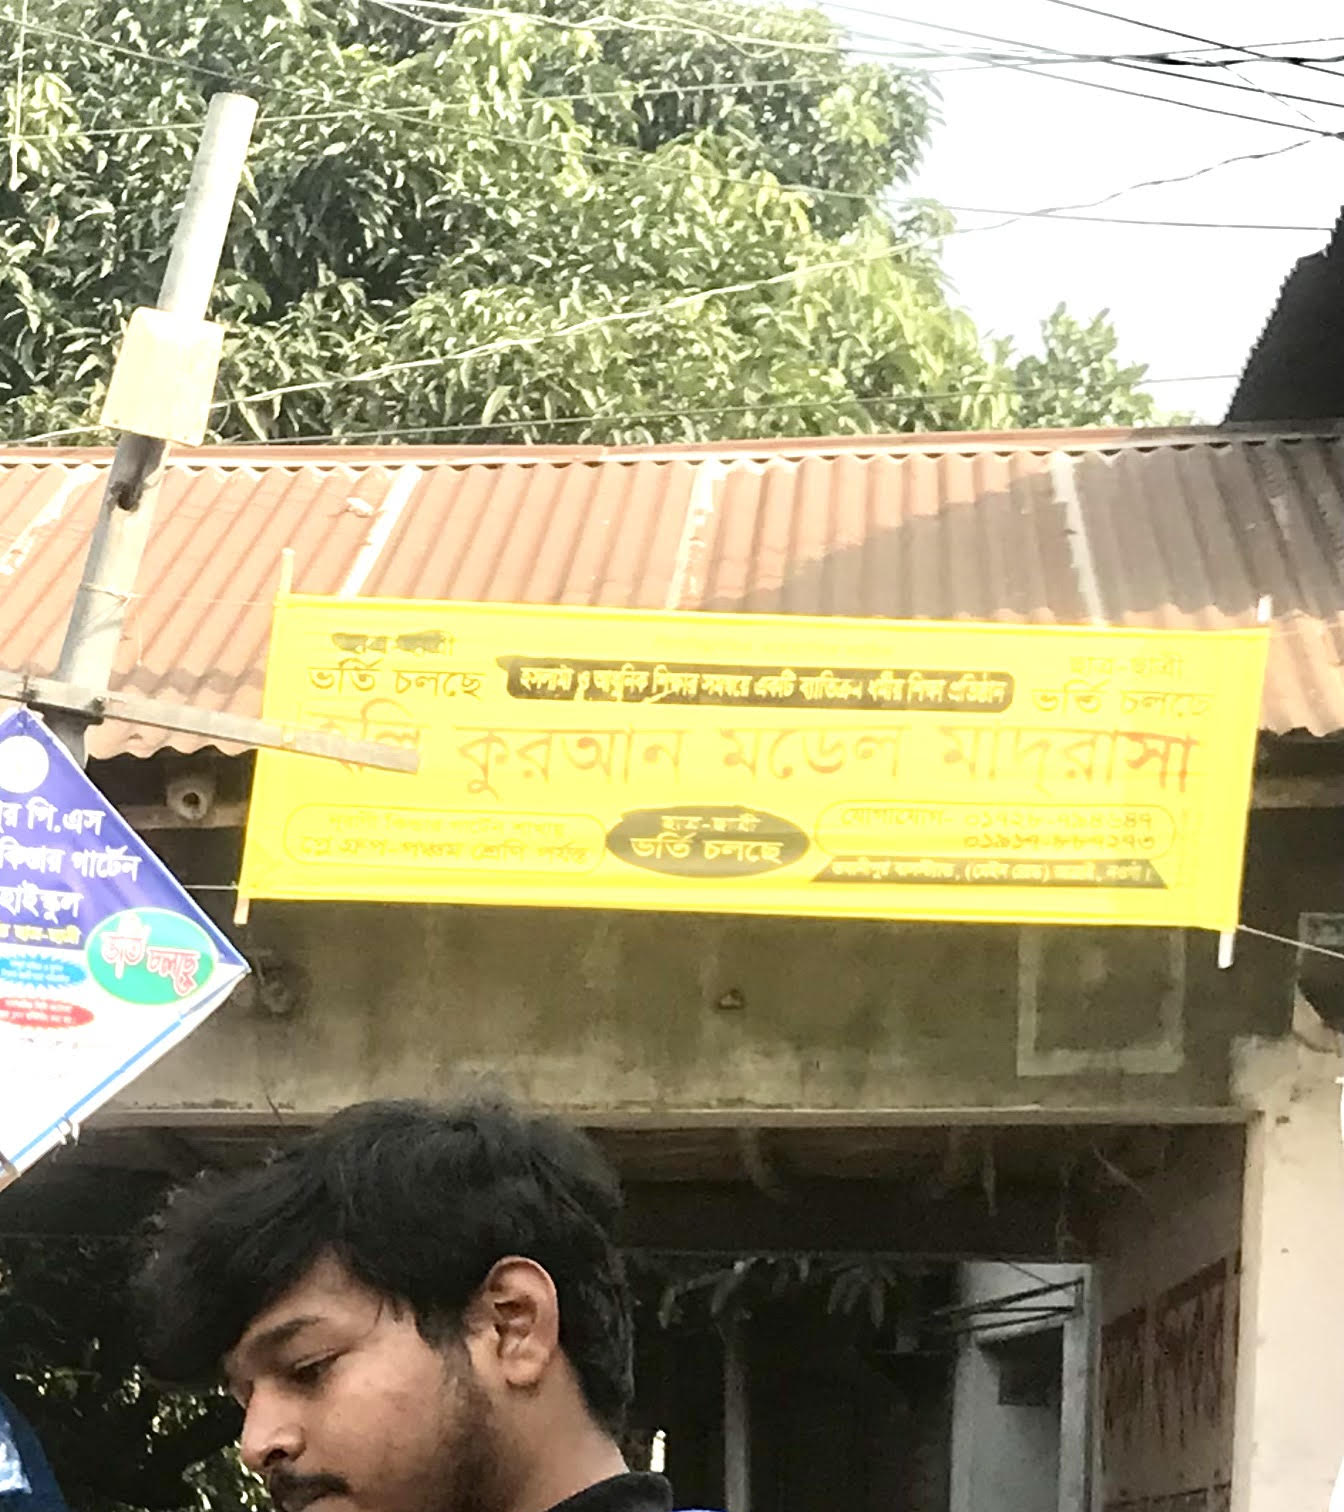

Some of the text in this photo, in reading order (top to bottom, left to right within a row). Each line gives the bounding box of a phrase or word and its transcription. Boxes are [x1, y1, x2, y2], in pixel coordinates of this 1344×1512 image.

[306, 657, 487, 700] ভর্তি চলছে
[1031, 678, 1111, 716] ভর্তি
[453, 717, 690, 802] কুরআন
[717, 720, 912, 784] মডেল
[25, 796, 107, 836] পি.এস
[70, 844, 143, 883] গার্টেন
[629, 832, 785, 865] ভর্তি চলছে
